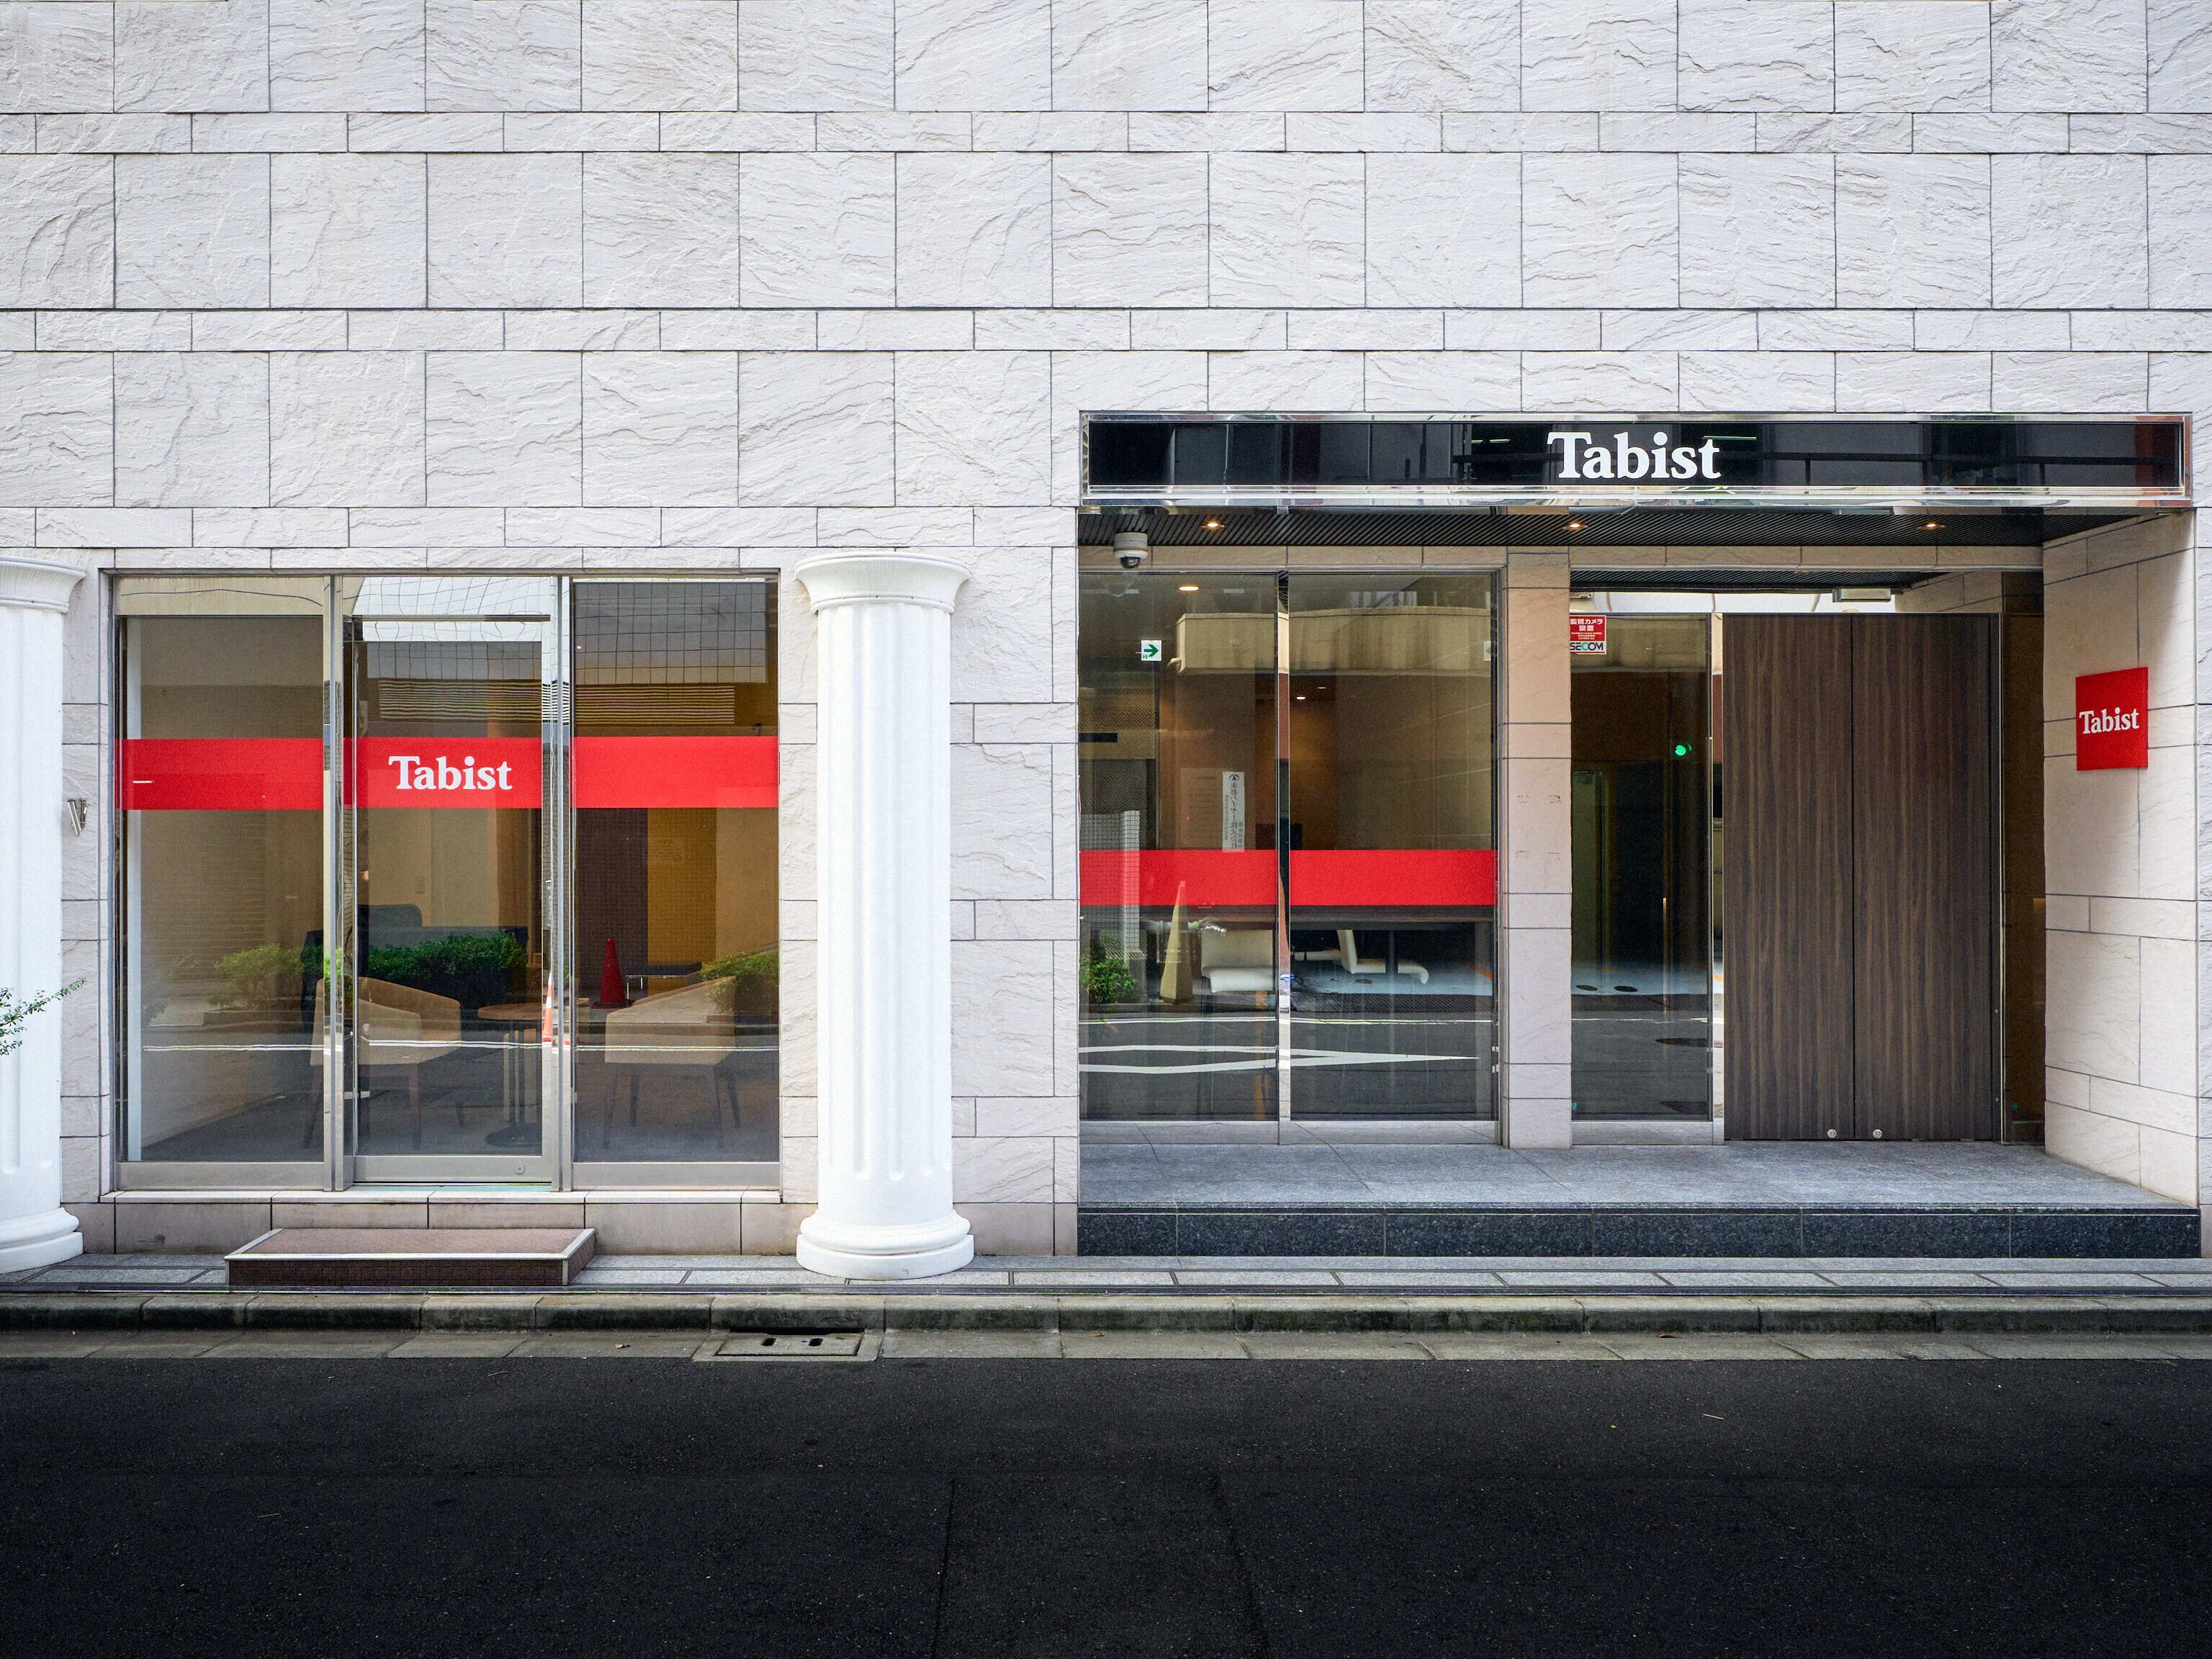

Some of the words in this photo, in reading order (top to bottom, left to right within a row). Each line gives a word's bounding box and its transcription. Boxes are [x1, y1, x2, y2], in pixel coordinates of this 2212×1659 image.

[1547, 431, 1722, 479] Tabist
[1570, 642, 1604, 651] SECOM
[2079, 707, 2139, 734] Tabist
[388, 756, 513, 790] Tabist
